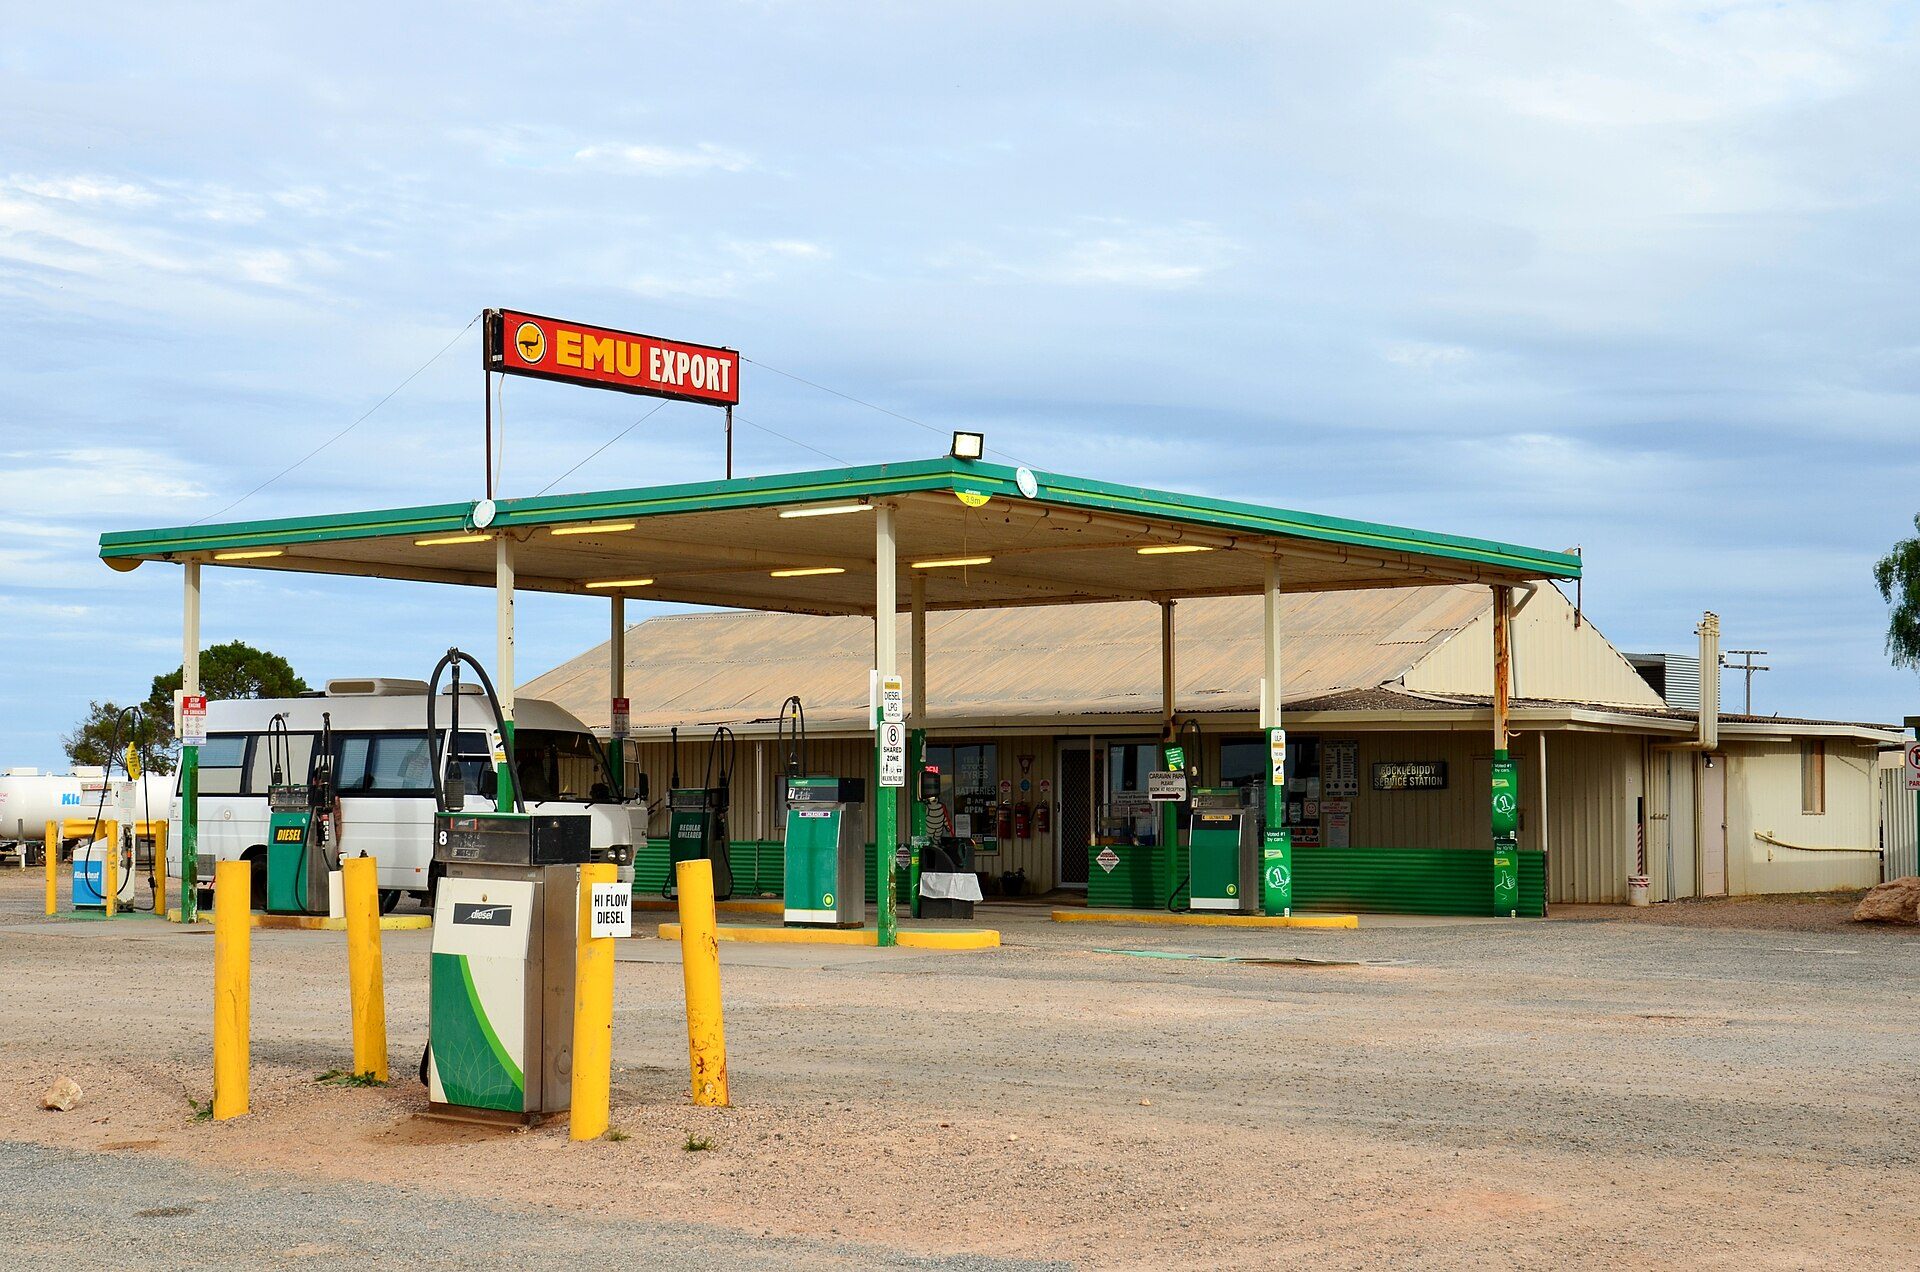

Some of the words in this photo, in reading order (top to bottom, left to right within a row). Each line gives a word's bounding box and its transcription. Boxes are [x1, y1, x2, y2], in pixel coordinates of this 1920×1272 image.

[556, 329, 641, 377] EMU
[649, 347, 731, 393] EXPORT
[965, 495, 981, 505] 3.9m
[884, 691, 901, 701] DIESEL
[887, 702, 898, 712] LPG
[889, 728, 897, 743] 8
[1380, 765, 1436, 776] COCKLEBIDDY
[1374, 776, 1408, 787] SERVICE
[1409, 776, 1443, 786] STATION
[788, 788, 795, 799] 7
[955, 786, 996, 796] BATTERIES
[276, 829, 301, 841] DIESEL
[438, 830, 448, 846] 8
[677, 831, 703, 839] UNLEADED
[594, 894, 604, 907] HI
[605, 894, 629, 907] FLOW
[470, 909, 494, 920] diesel
[597, 911, 625, 924] DIESEL
